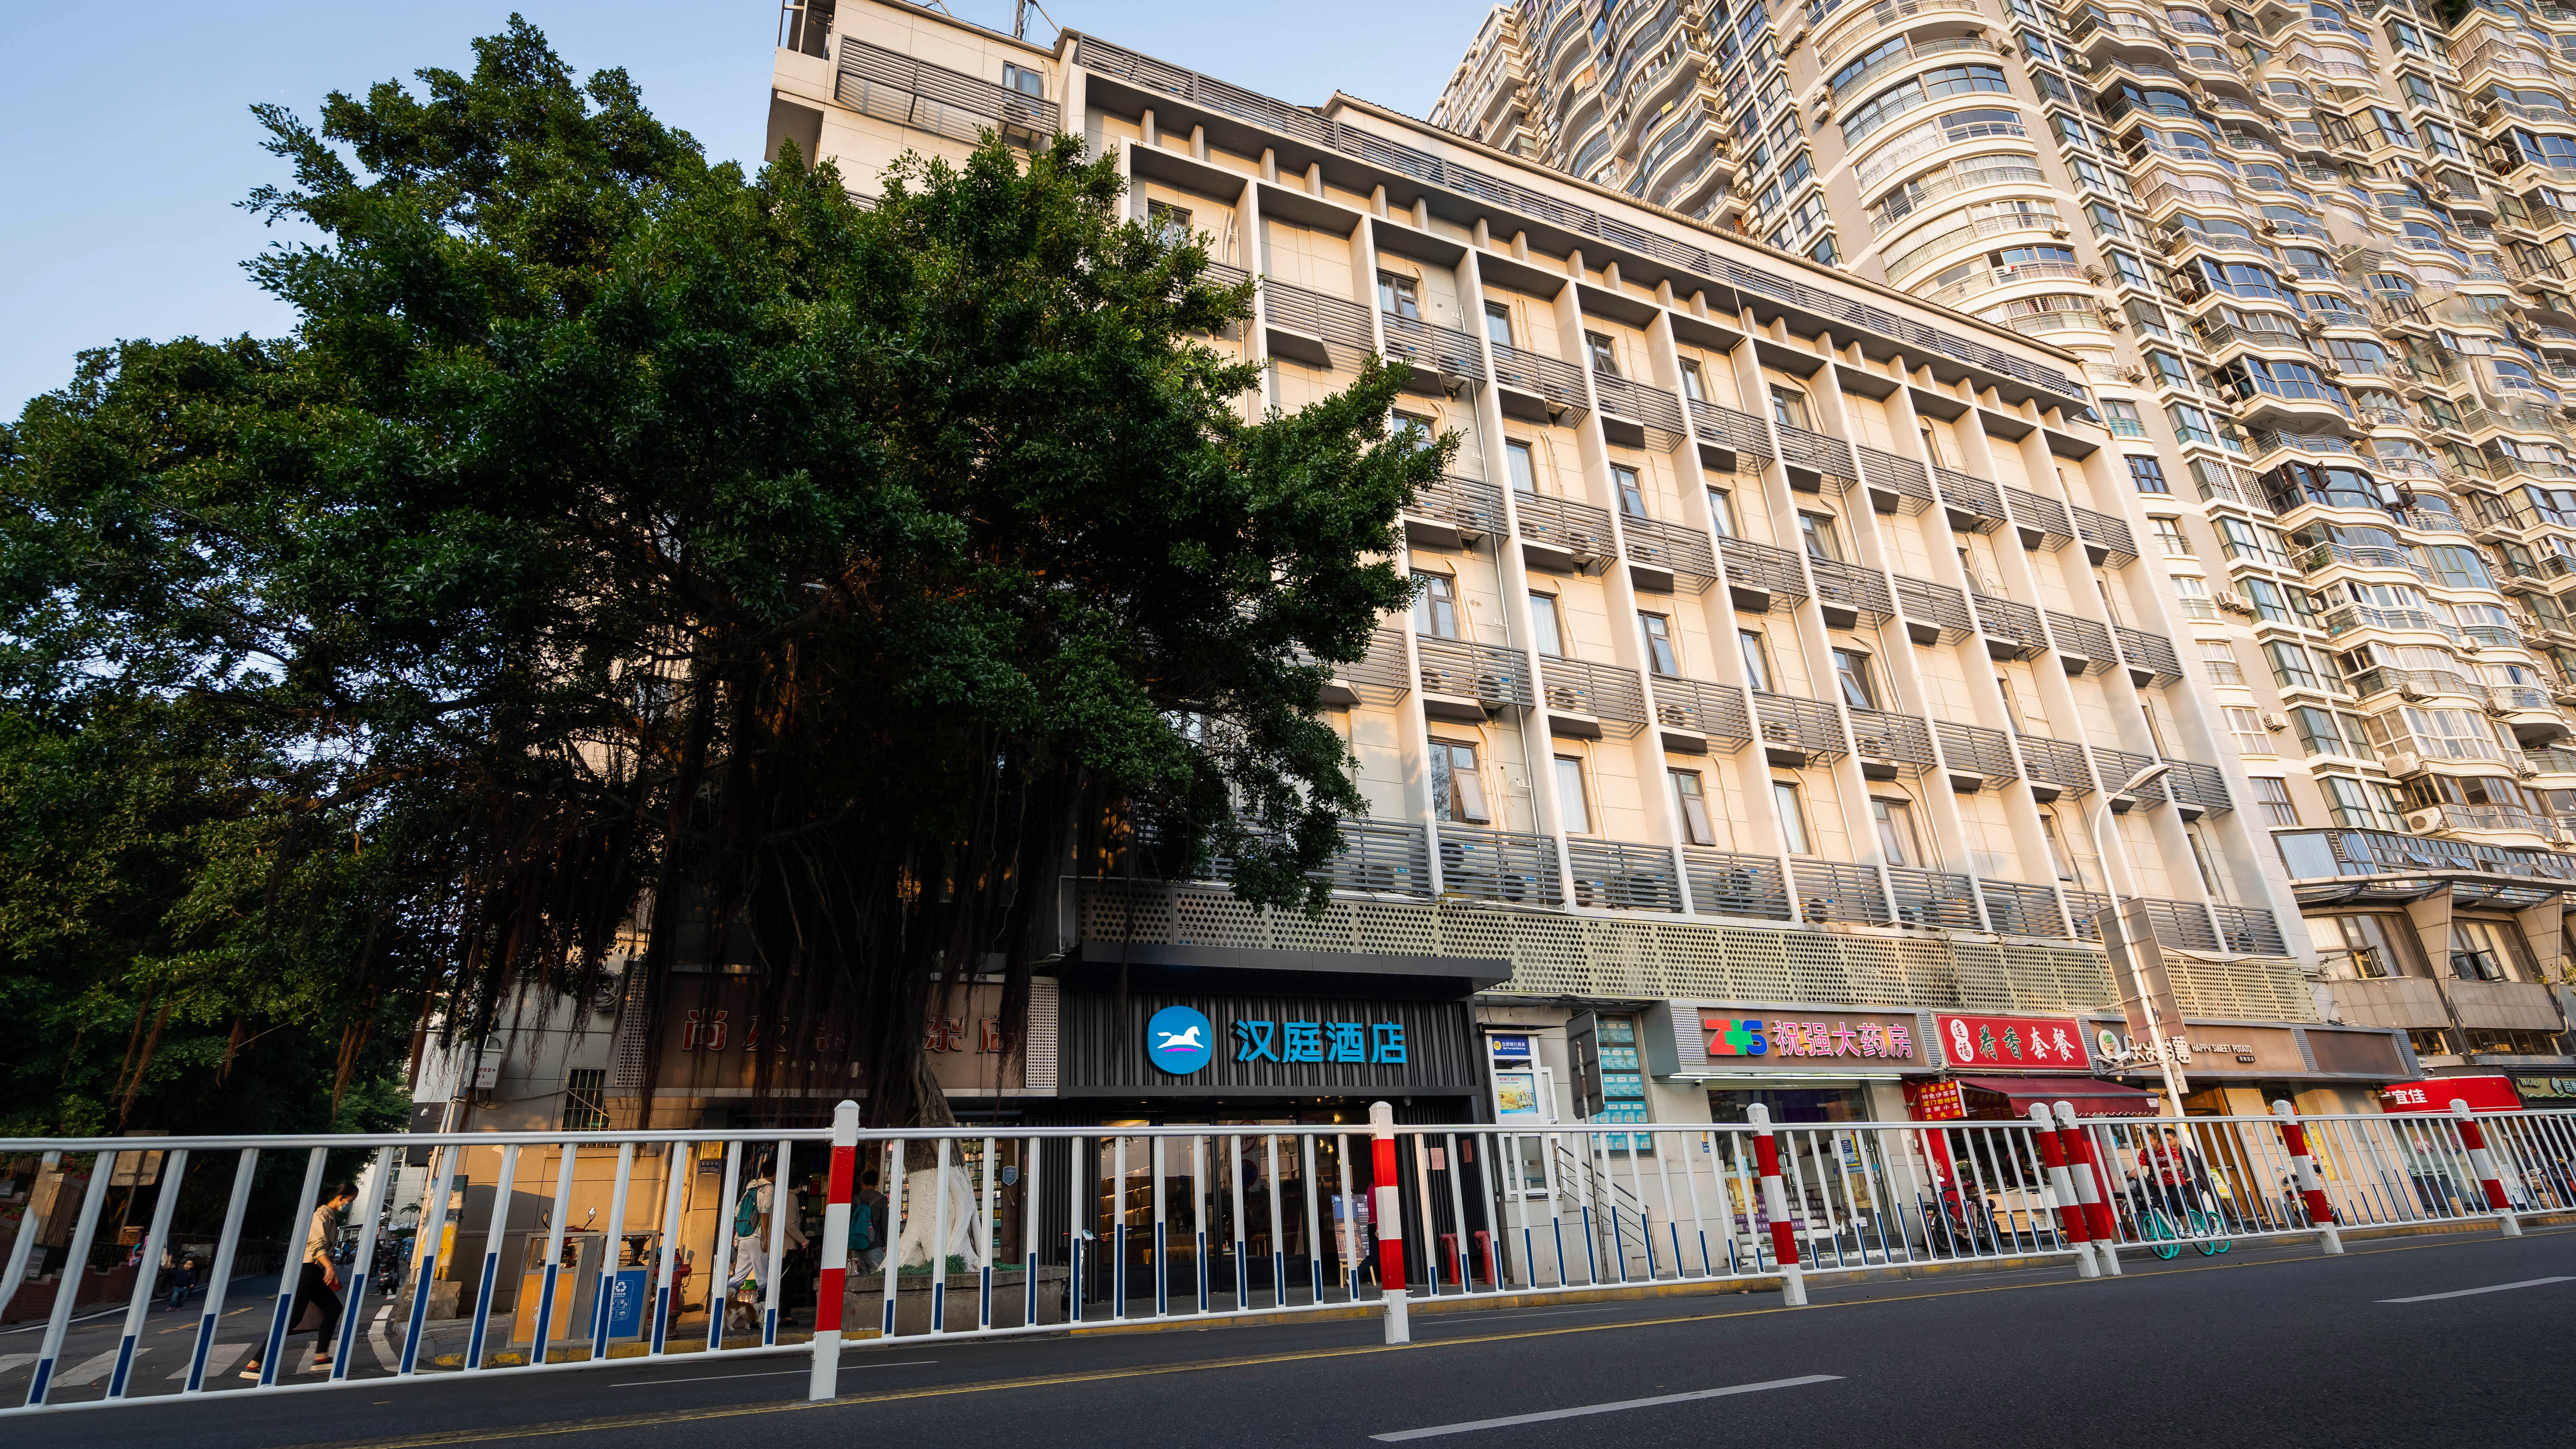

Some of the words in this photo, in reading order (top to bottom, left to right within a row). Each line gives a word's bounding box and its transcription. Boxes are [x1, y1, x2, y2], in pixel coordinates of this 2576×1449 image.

[1236, 1019, 1407, 1064] 汉庭酒店
[1772, 1020, 1913, 1058] 祝强大药房
[1979, 1024, 2075, 1062] 荷香套餐
[2191, 1044, 2211, 1052] HAPPY
[2212, 1044, 2231, 1053] SWEET
[2232, 1044, 2252, 1053] POTATO
[1920, 1083, 1955, 1094] 荷香套餐
[1922, 1089, 1956, 1100] 特色沙茶面
[2381, 1088, 2428, 1105] 宜佳
[1923, 1096, 1958, 1106] 厦门面线糊
[1925, 1102, 1959, 1113] 清粥小菜
